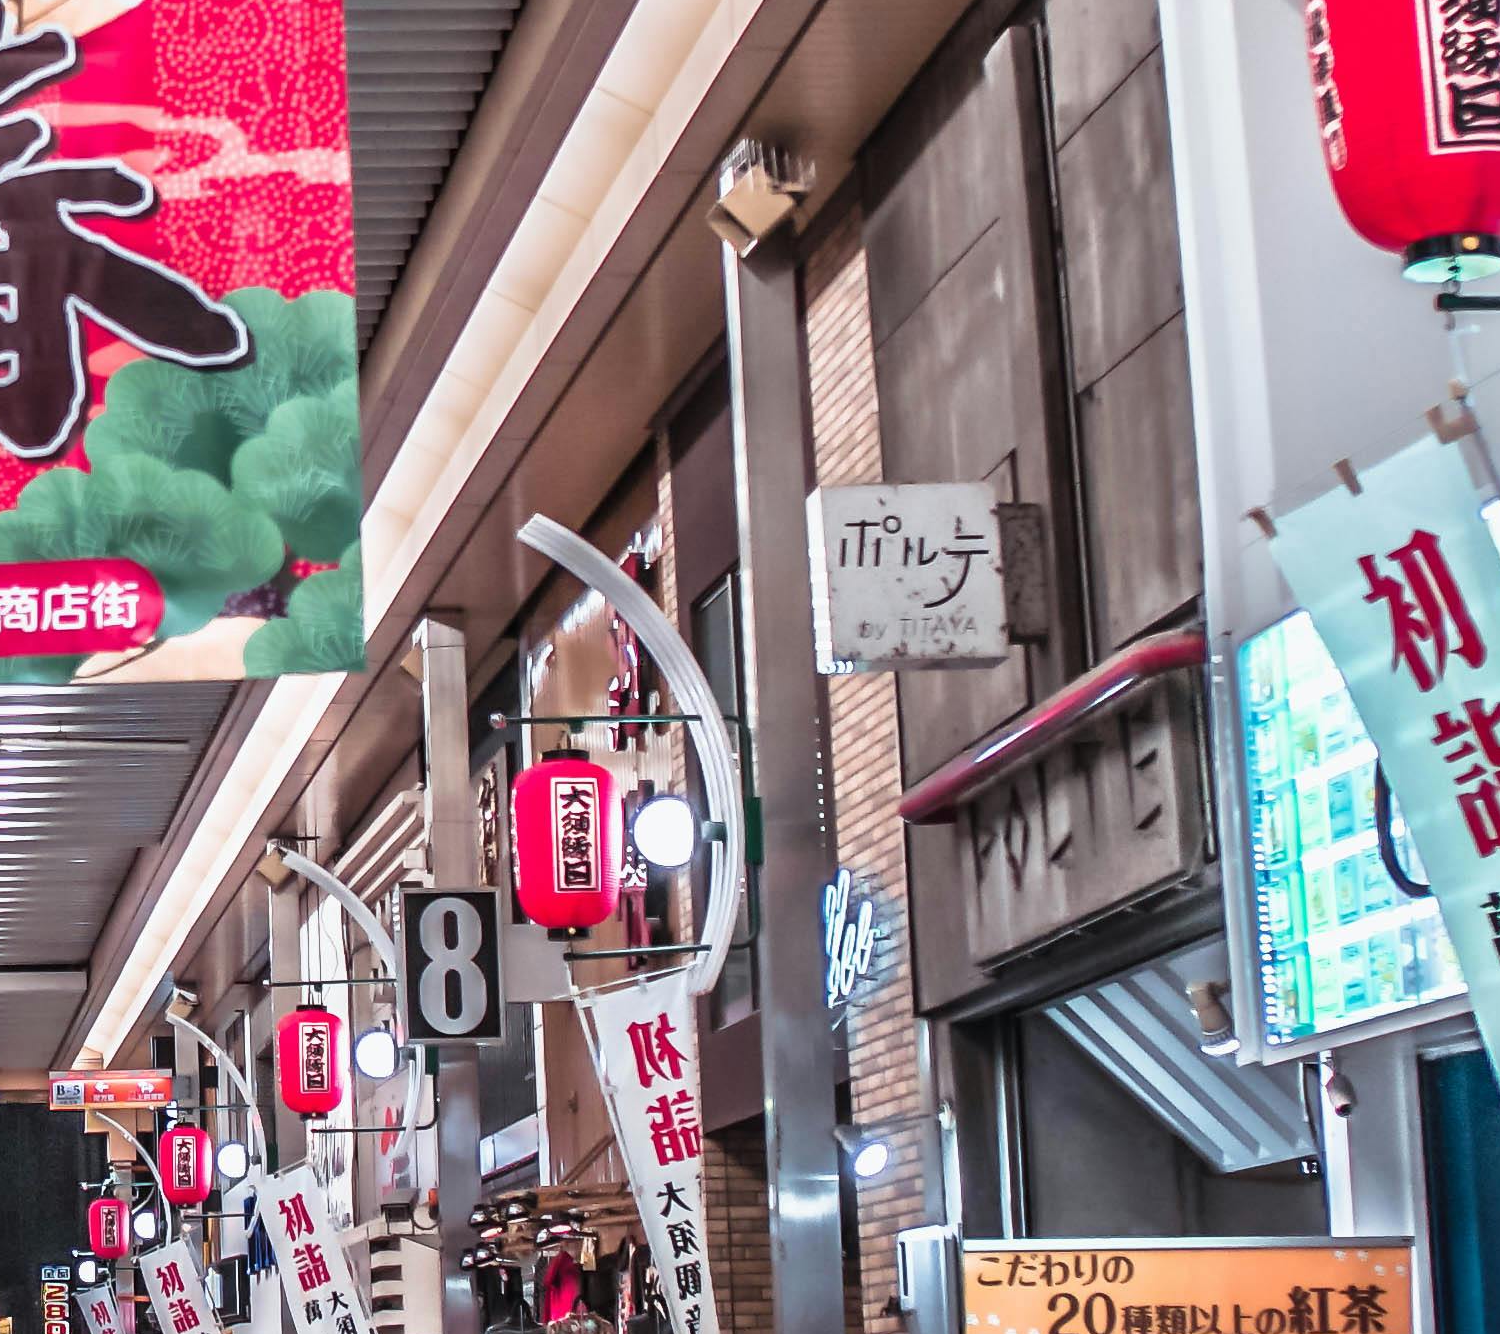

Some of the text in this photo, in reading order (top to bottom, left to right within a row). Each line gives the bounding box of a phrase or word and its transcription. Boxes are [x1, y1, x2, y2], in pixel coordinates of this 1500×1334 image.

[840, 514, 989, 609] ポルテ
[418, 896, 489, 1036] 8
[279, 1192, 332, 1293] 初詣
[976, 1255, 1135, 1287] こだわりの
